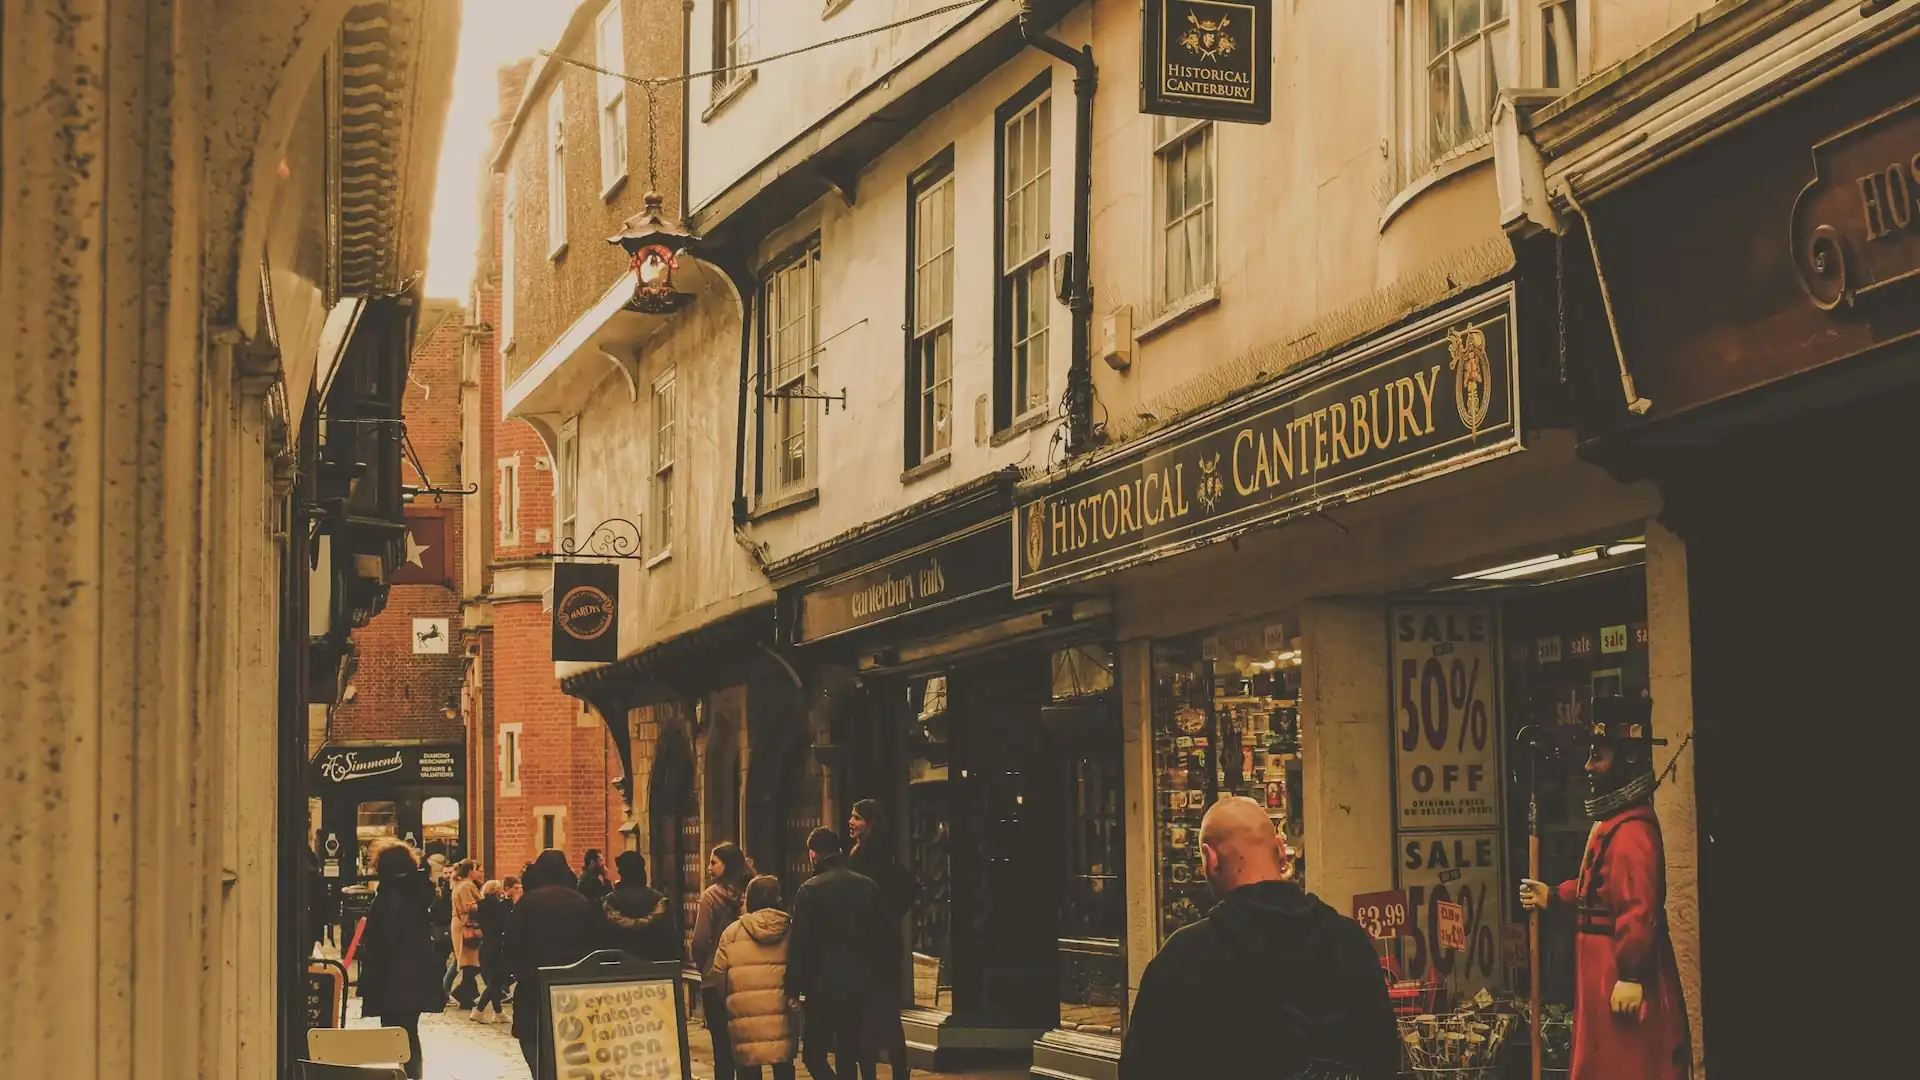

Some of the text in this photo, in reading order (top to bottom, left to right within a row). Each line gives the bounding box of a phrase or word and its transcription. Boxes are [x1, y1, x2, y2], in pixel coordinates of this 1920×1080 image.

[1168, 63, 1249, 84] HISTORICAL
[1167, 78, 1249, 98] CANTERBURY
[1051, 365, 1441, 556] HISTORICAL CANTERBURY
[852, 573, 914, 618] canterbury
[1399, 613, 1485, 642] SALE
[1604, 631, 1624, 648] sale
[1636, 629, 1648, 643] sa
[1571, 636, 1590, 653] sale
[1402, 656, 1488, 753] 50%
[1556, 689, 1582, 726] sale
[1412, 764, 1484, 793] OFF
[1405, 840, 1492, 870] SALE
[1357, 903, 1405, 937] £3.99
[1408, 882, 1494, 980] 50%
[585, 986, 668, 1009] everyday
[587, 1004, 652, 1025] vintage
[591, 1020, 664, 1042] fashions
[595, 1039, 662, 1065] open
[600, 1057, 670, 1080] every
